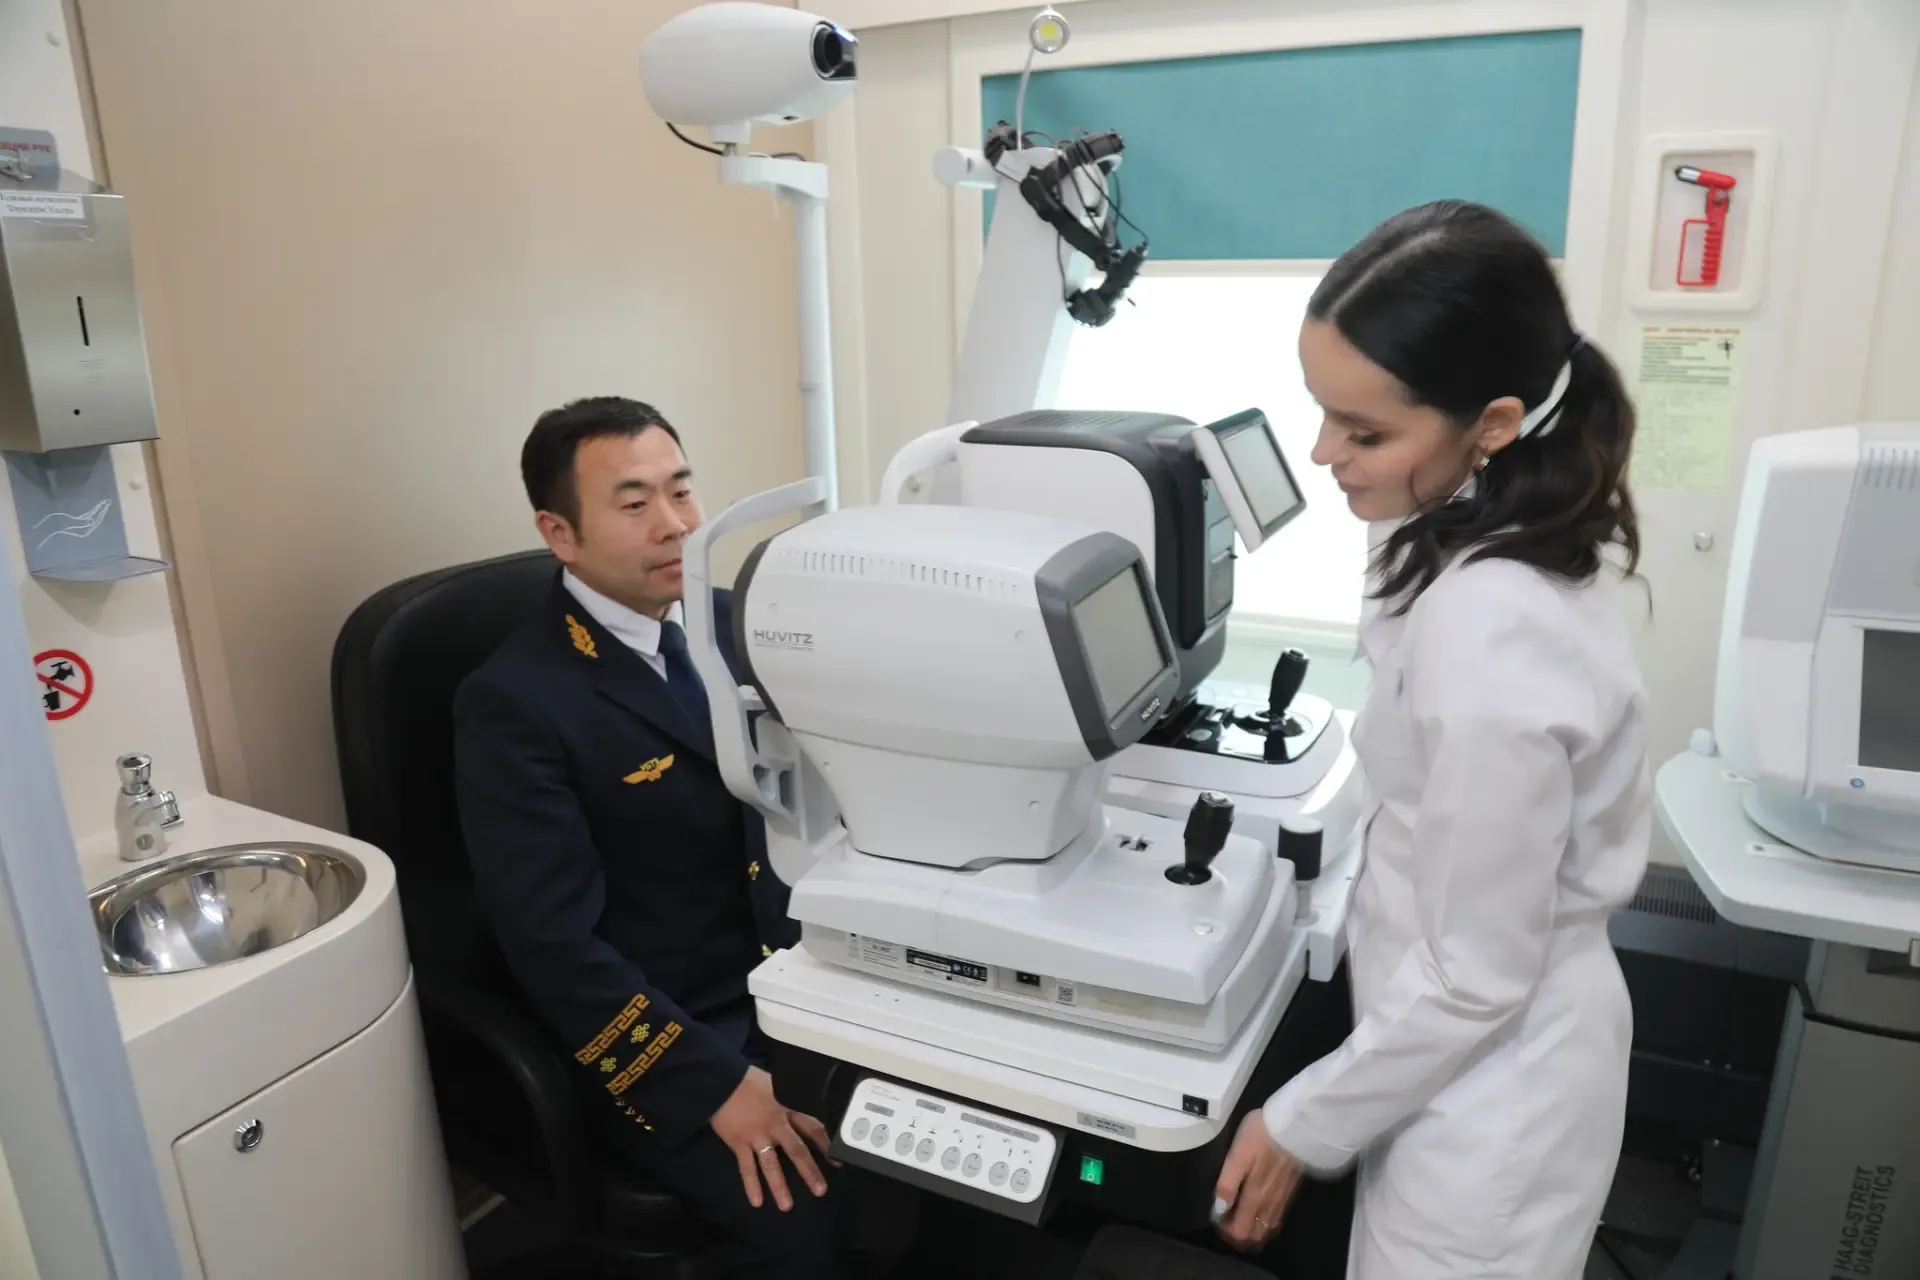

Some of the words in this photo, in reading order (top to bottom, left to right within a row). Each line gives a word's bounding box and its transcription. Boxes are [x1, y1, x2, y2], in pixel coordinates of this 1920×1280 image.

[754, 629, 814, 644] HUVITZ
[1833, 1165, 1873, 1272] HAAG-STREIT
[1853, 1165, 1895, 1276] DIAGNOSTICS
